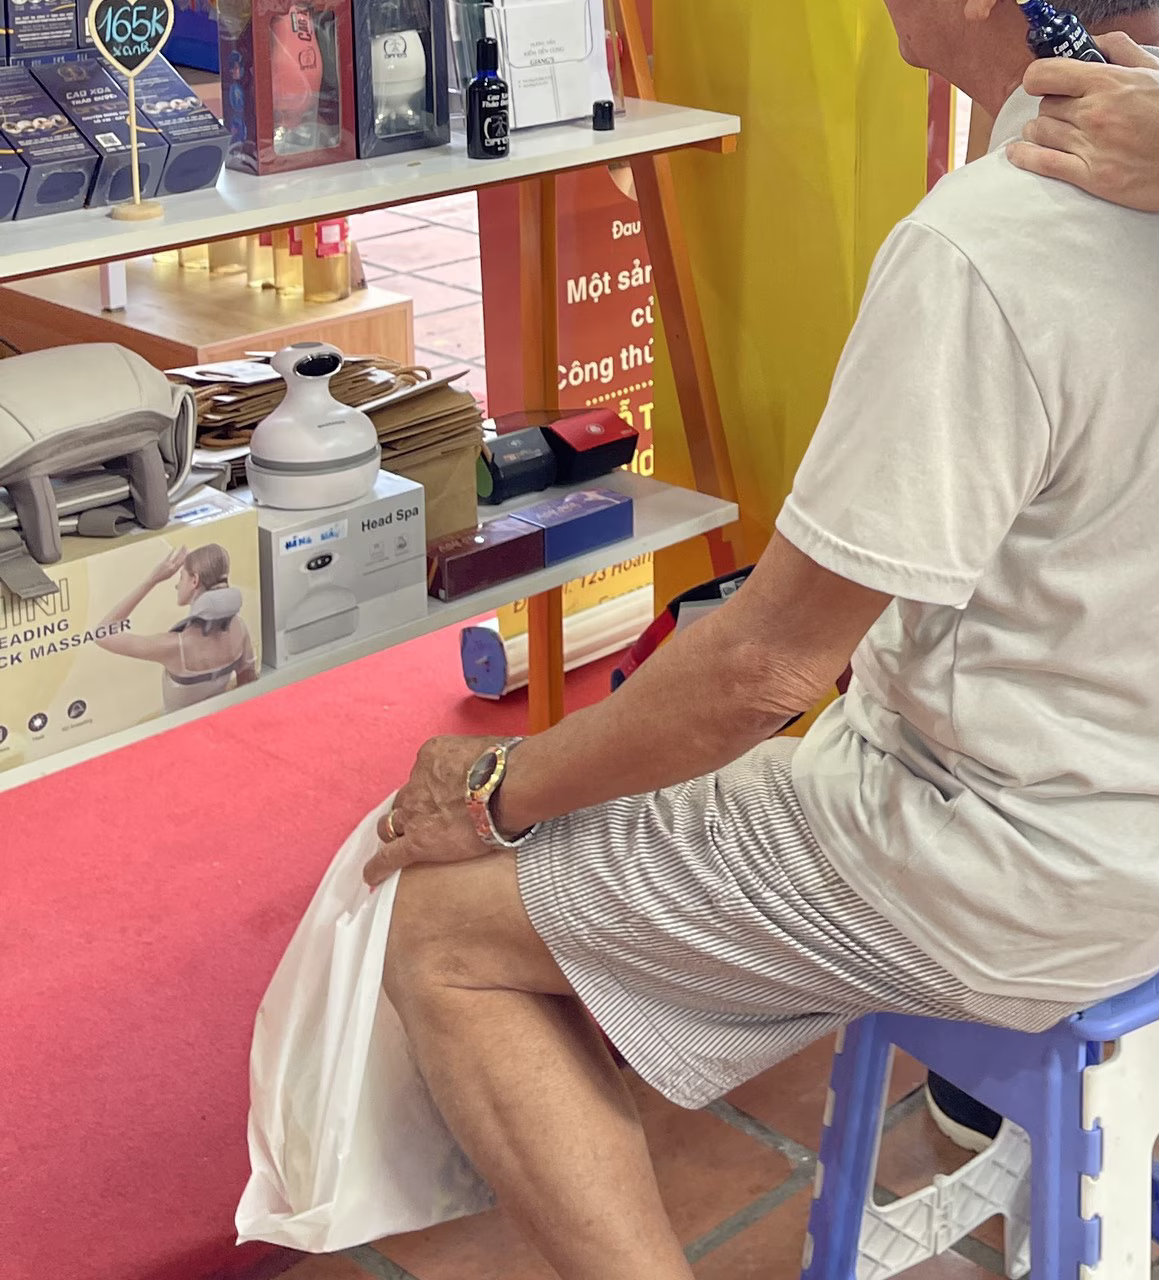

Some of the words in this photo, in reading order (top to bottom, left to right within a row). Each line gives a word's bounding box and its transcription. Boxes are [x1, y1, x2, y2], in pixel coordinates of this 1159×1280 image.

[98, 5, 167, 43] 165K
[612, 220, 641, 239] Đau
[566, 272, 611, 304] Một
[361, 512, 393, 533] Head
[396, 506, 419, 522] Spa
[30, 618, 131, 660] MASSAGER
